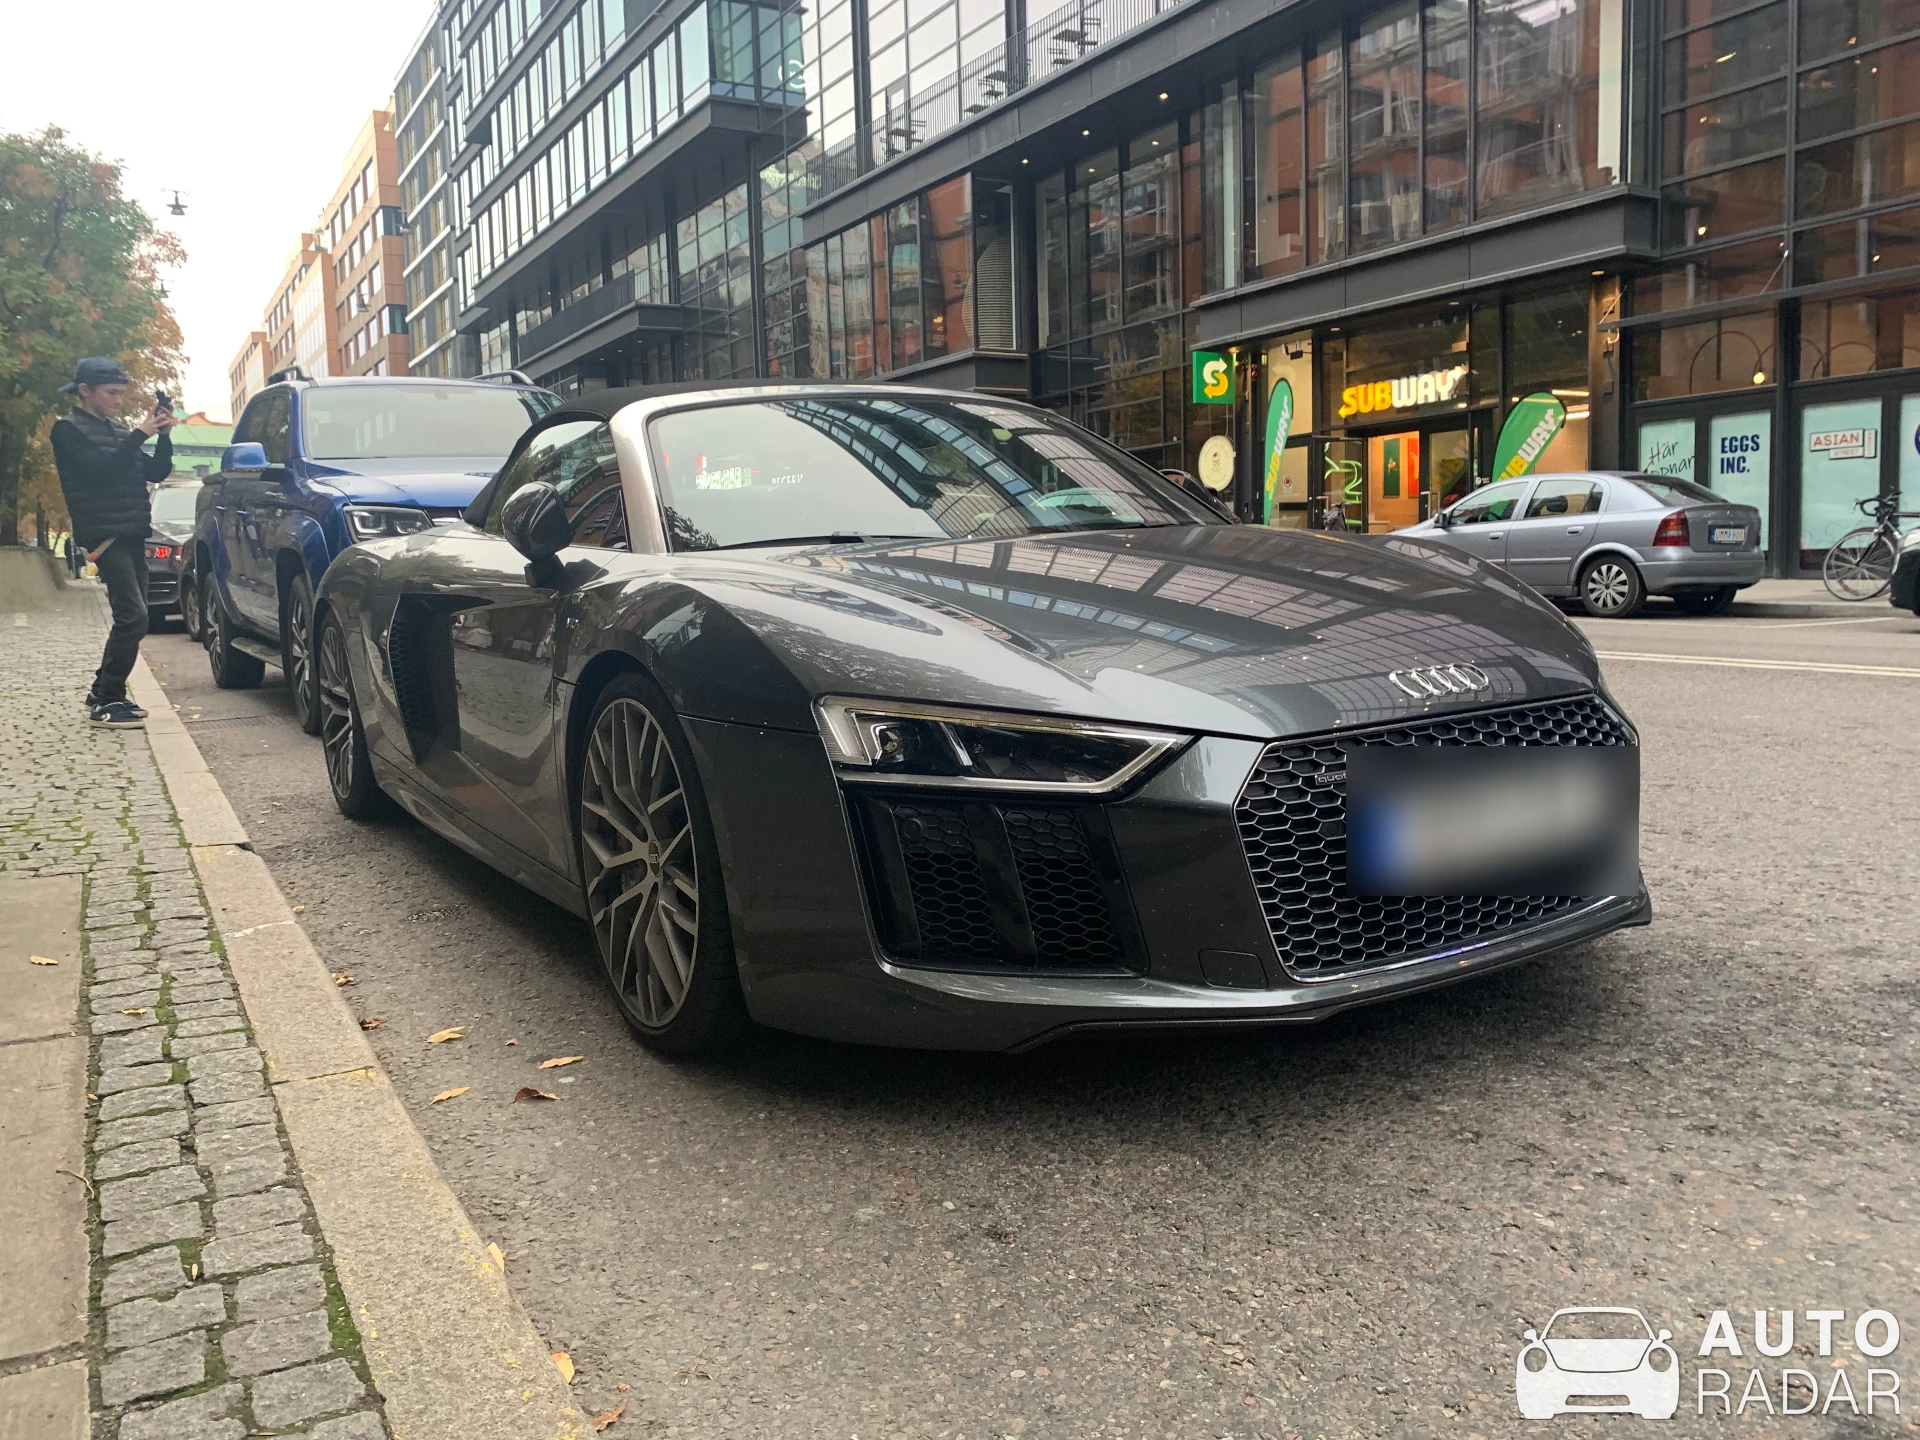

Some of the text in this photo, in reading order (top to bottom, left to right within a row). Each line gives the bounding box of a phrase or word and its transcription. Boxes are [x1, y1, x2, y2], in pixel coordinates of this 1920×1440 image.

[1338, 361, 1469, 418] SUBWAY
[1265, 394, 1291, 500] SUBWAY
[1720, 434, 1760, 454] EGGS
[1813, 432, 1860, 447] ASIAN
[1648, 440, 1679, 465] Här
[1720, 456, 1751, 475] INC.
